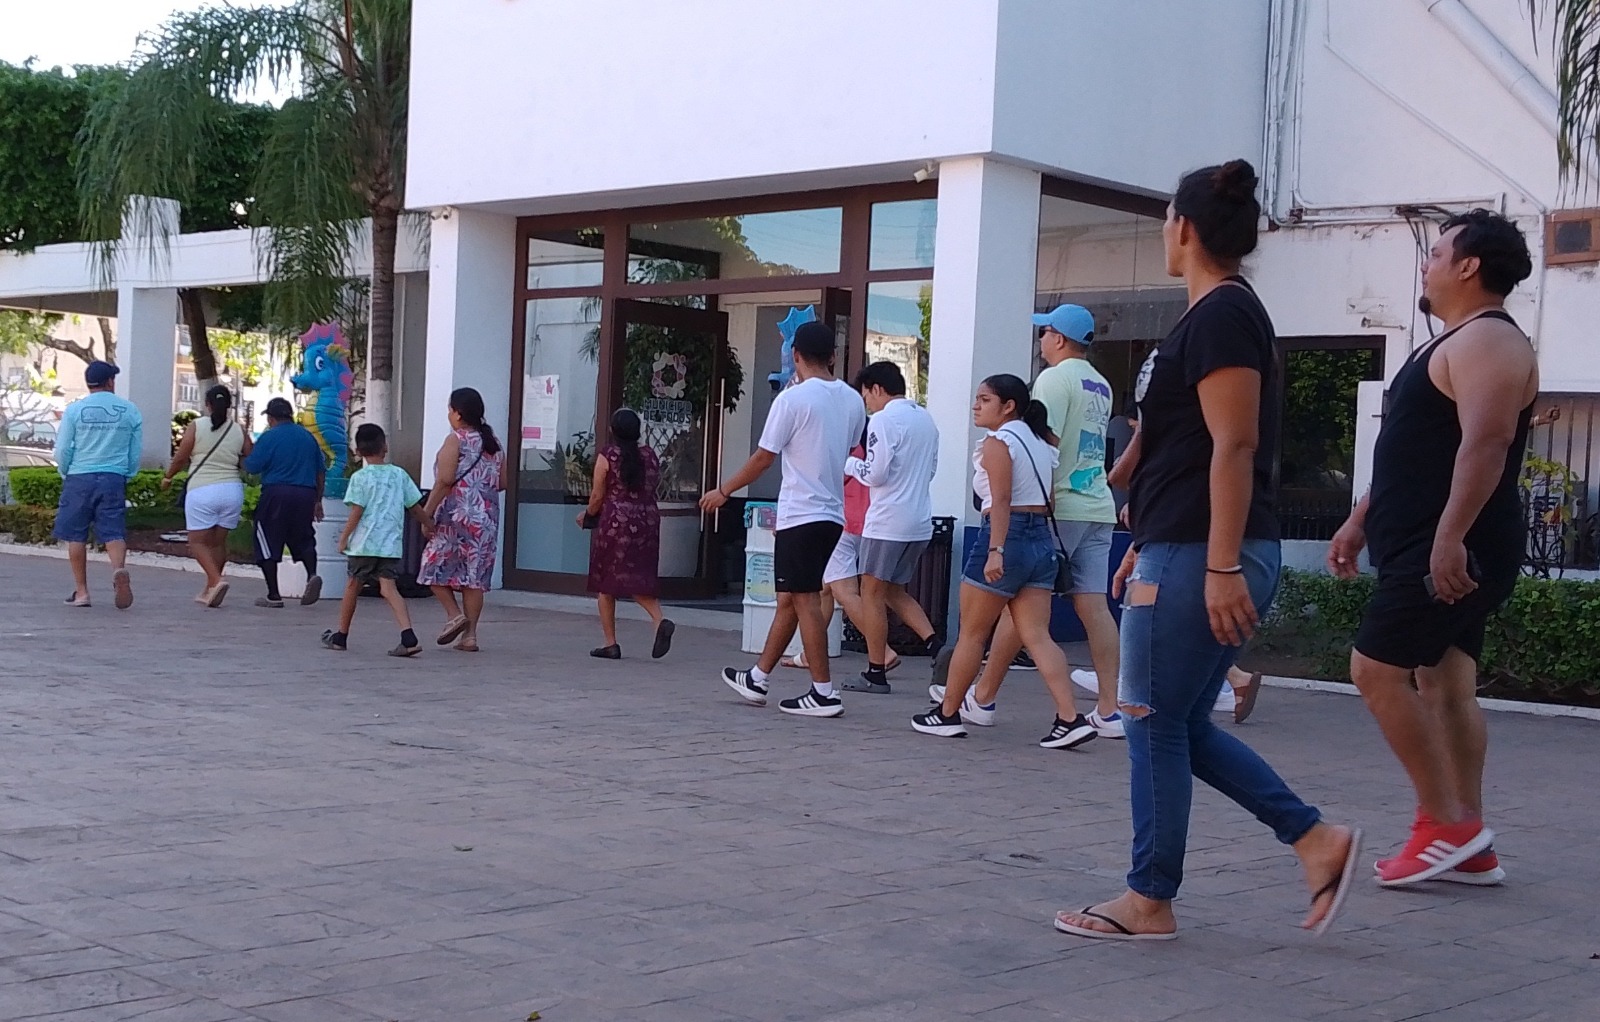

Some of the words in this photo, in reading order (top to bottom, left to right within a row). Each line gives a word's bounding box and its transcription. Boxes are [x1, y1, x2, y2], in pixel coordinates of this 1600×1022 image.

[643, 398, 692, 412] MUNICIPIO
[643, 410, 656, 421] DE
[660, 410, 692, 424] TODOS
